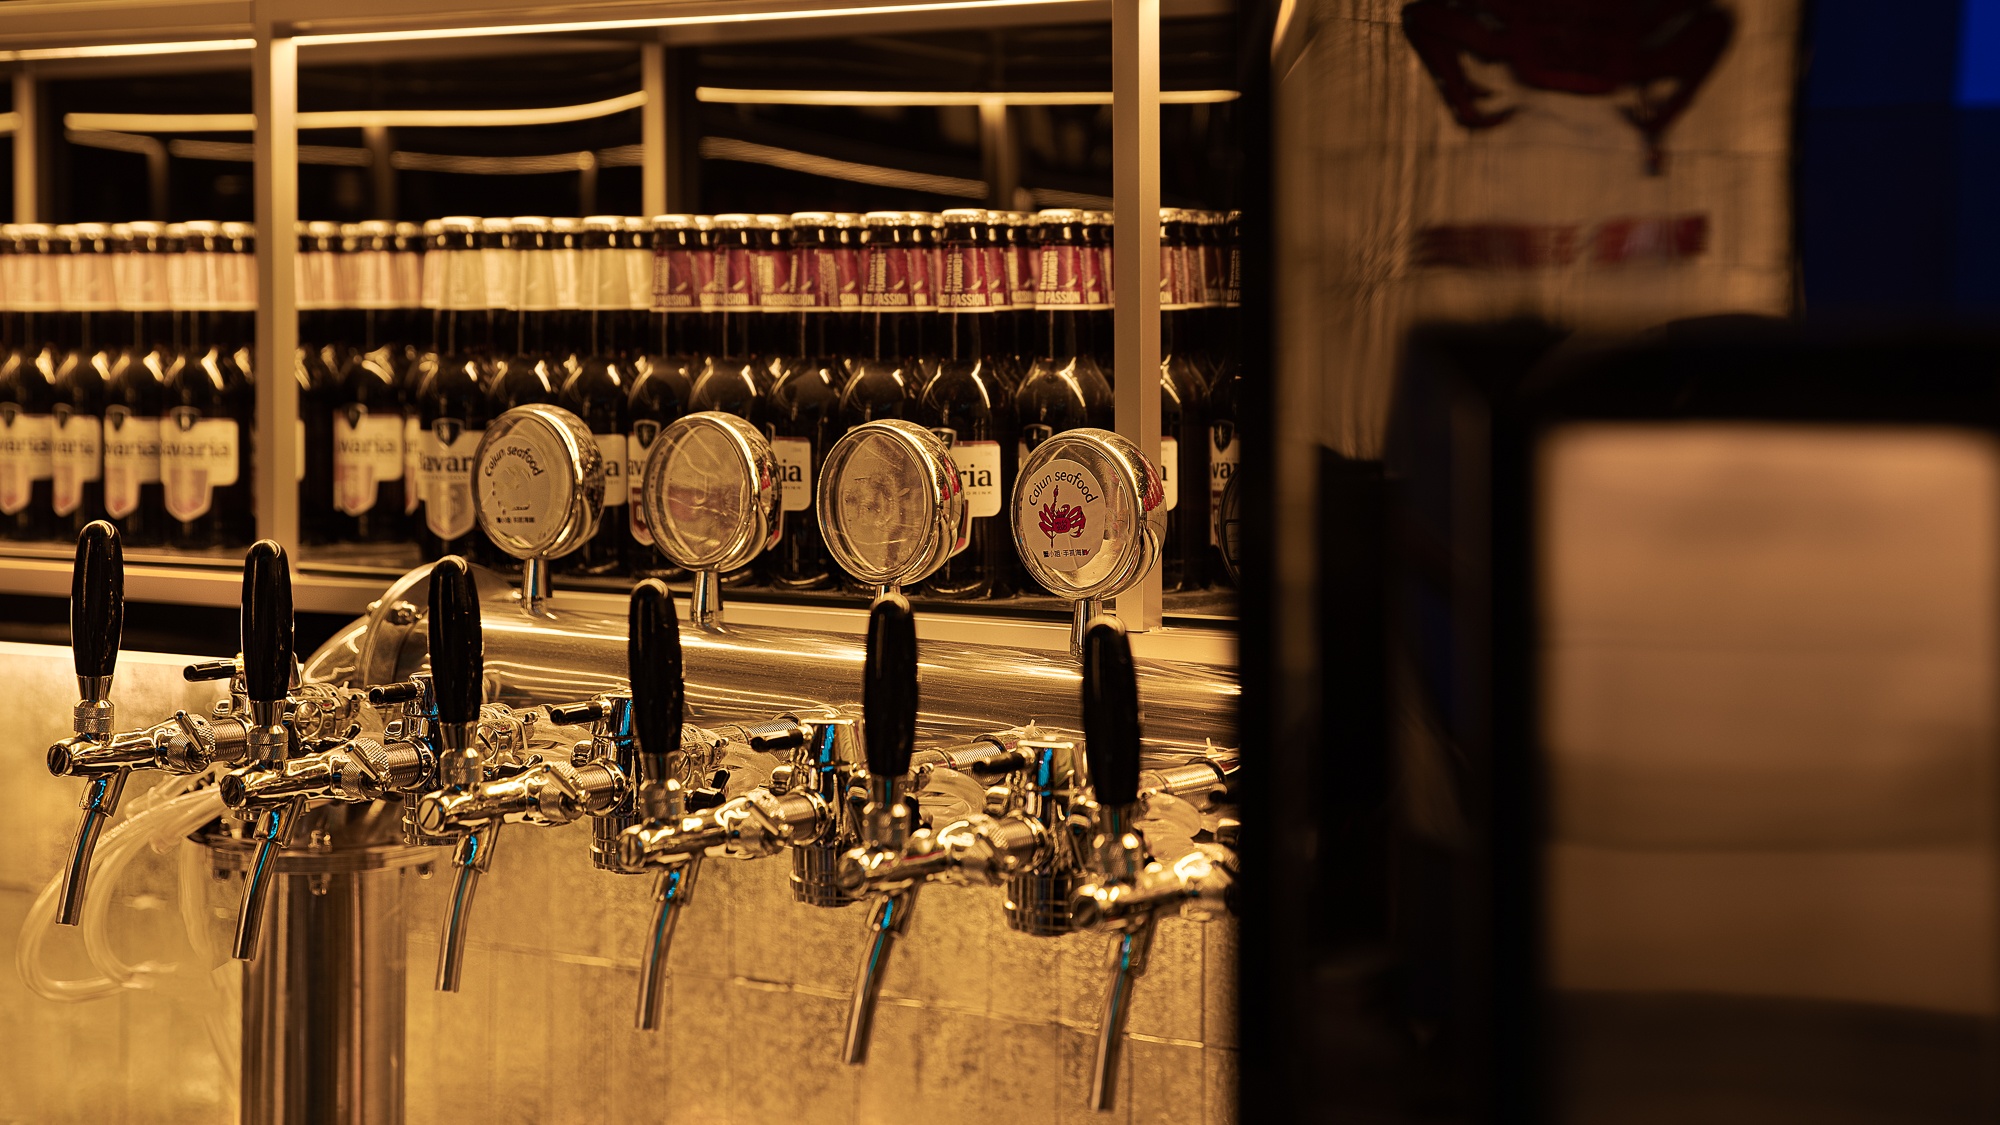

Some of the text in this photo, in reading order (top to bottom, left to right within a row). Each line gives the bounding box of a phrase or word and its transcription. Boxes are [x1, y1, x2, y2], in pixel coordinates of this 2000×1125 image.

[944, 253, 952, 292] Bavaria
[873, 293, 908, 305] PASSION
[951, 293, 986, 306] PASSION
[1045, 291, 1081, 304] PASSION
[506, 446, 545, 477] seafood
[1054, 471, 1099, 504] seafood
